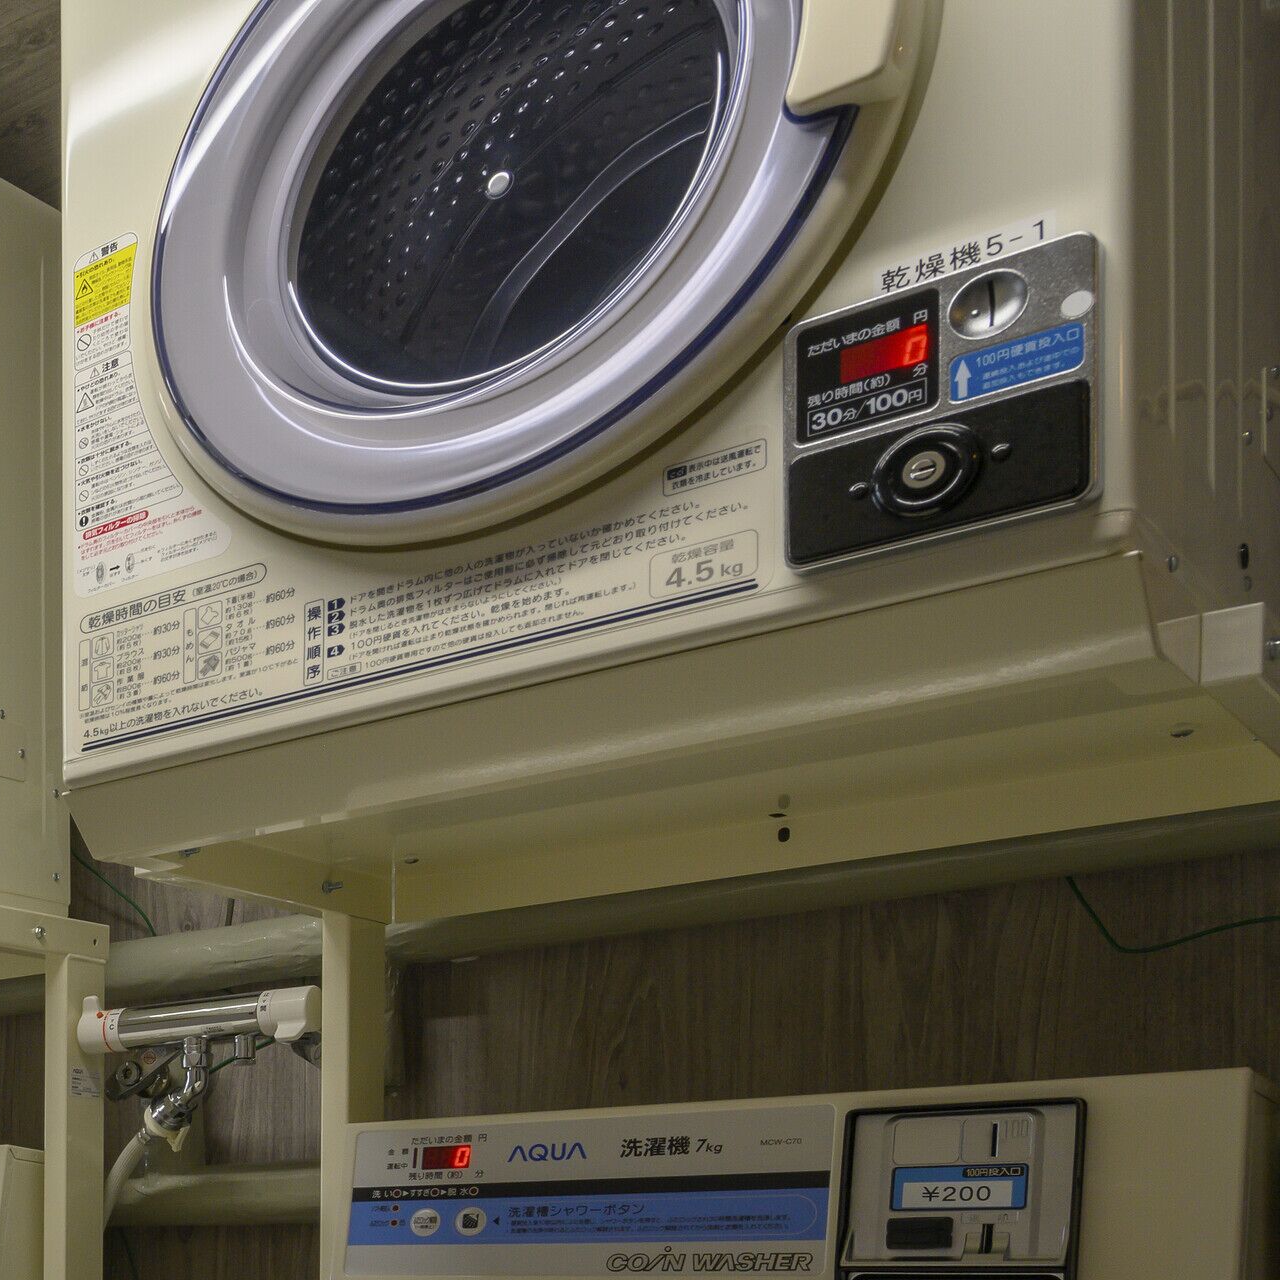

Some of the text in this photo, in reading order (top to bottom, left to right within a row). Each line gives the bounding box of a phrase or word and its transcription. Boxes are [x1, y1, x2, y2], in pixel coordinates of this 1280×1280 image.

[101, 242, 118, 257] 警告
[881, 220, 1045, 292] 乾燥機5-1
[807, 309, 928, 357] ただいまの金額 円
[902, 336, 927, 366] 0
[976, 328, 1080, 368] 100円硬貨投入口
[102, 358, 119, 373] 注意
[913, 363, 928, 377] 分
[812, 386, 924, 431] 30分/100円
[671, 538, 736, 564] 乾燥容量
[665, 559, 744, 588] 4.5 kg
[265, 587, 295, 603] 約60分
[88, 589, 186, 629] 乾燥時間の目安
[153, 621, 180, 635] 約30分
[265, 614, 295, 630] 約60分
[117, 649, 144, 661] ブラウス
[153, 646, 180, 660] 約30分
[225, 643, 256, 656] パジャマ
[265, 640, 295, 656] 約60分
[153, 672, 180, 685] 約60分
[411, 1133, 487, 1146] ただいまの金額 円
[454, 1147, 470, 1167] 0
[507, 1136, 802, 1163] AQUA 洗濯機 7kg MCW-C70
[474, 1169, 484, 1178] 分
[966, 1167, 1021, 1177] 100円投入口
[410, 1189, 429, 1197] すすぎ
[922, 1186, 991, 1201] ¥200
[507, 1204, 645, 1218] 洗濯槽シャワーボタン
[606, 1245, 813, 1272] COIN WASHER
